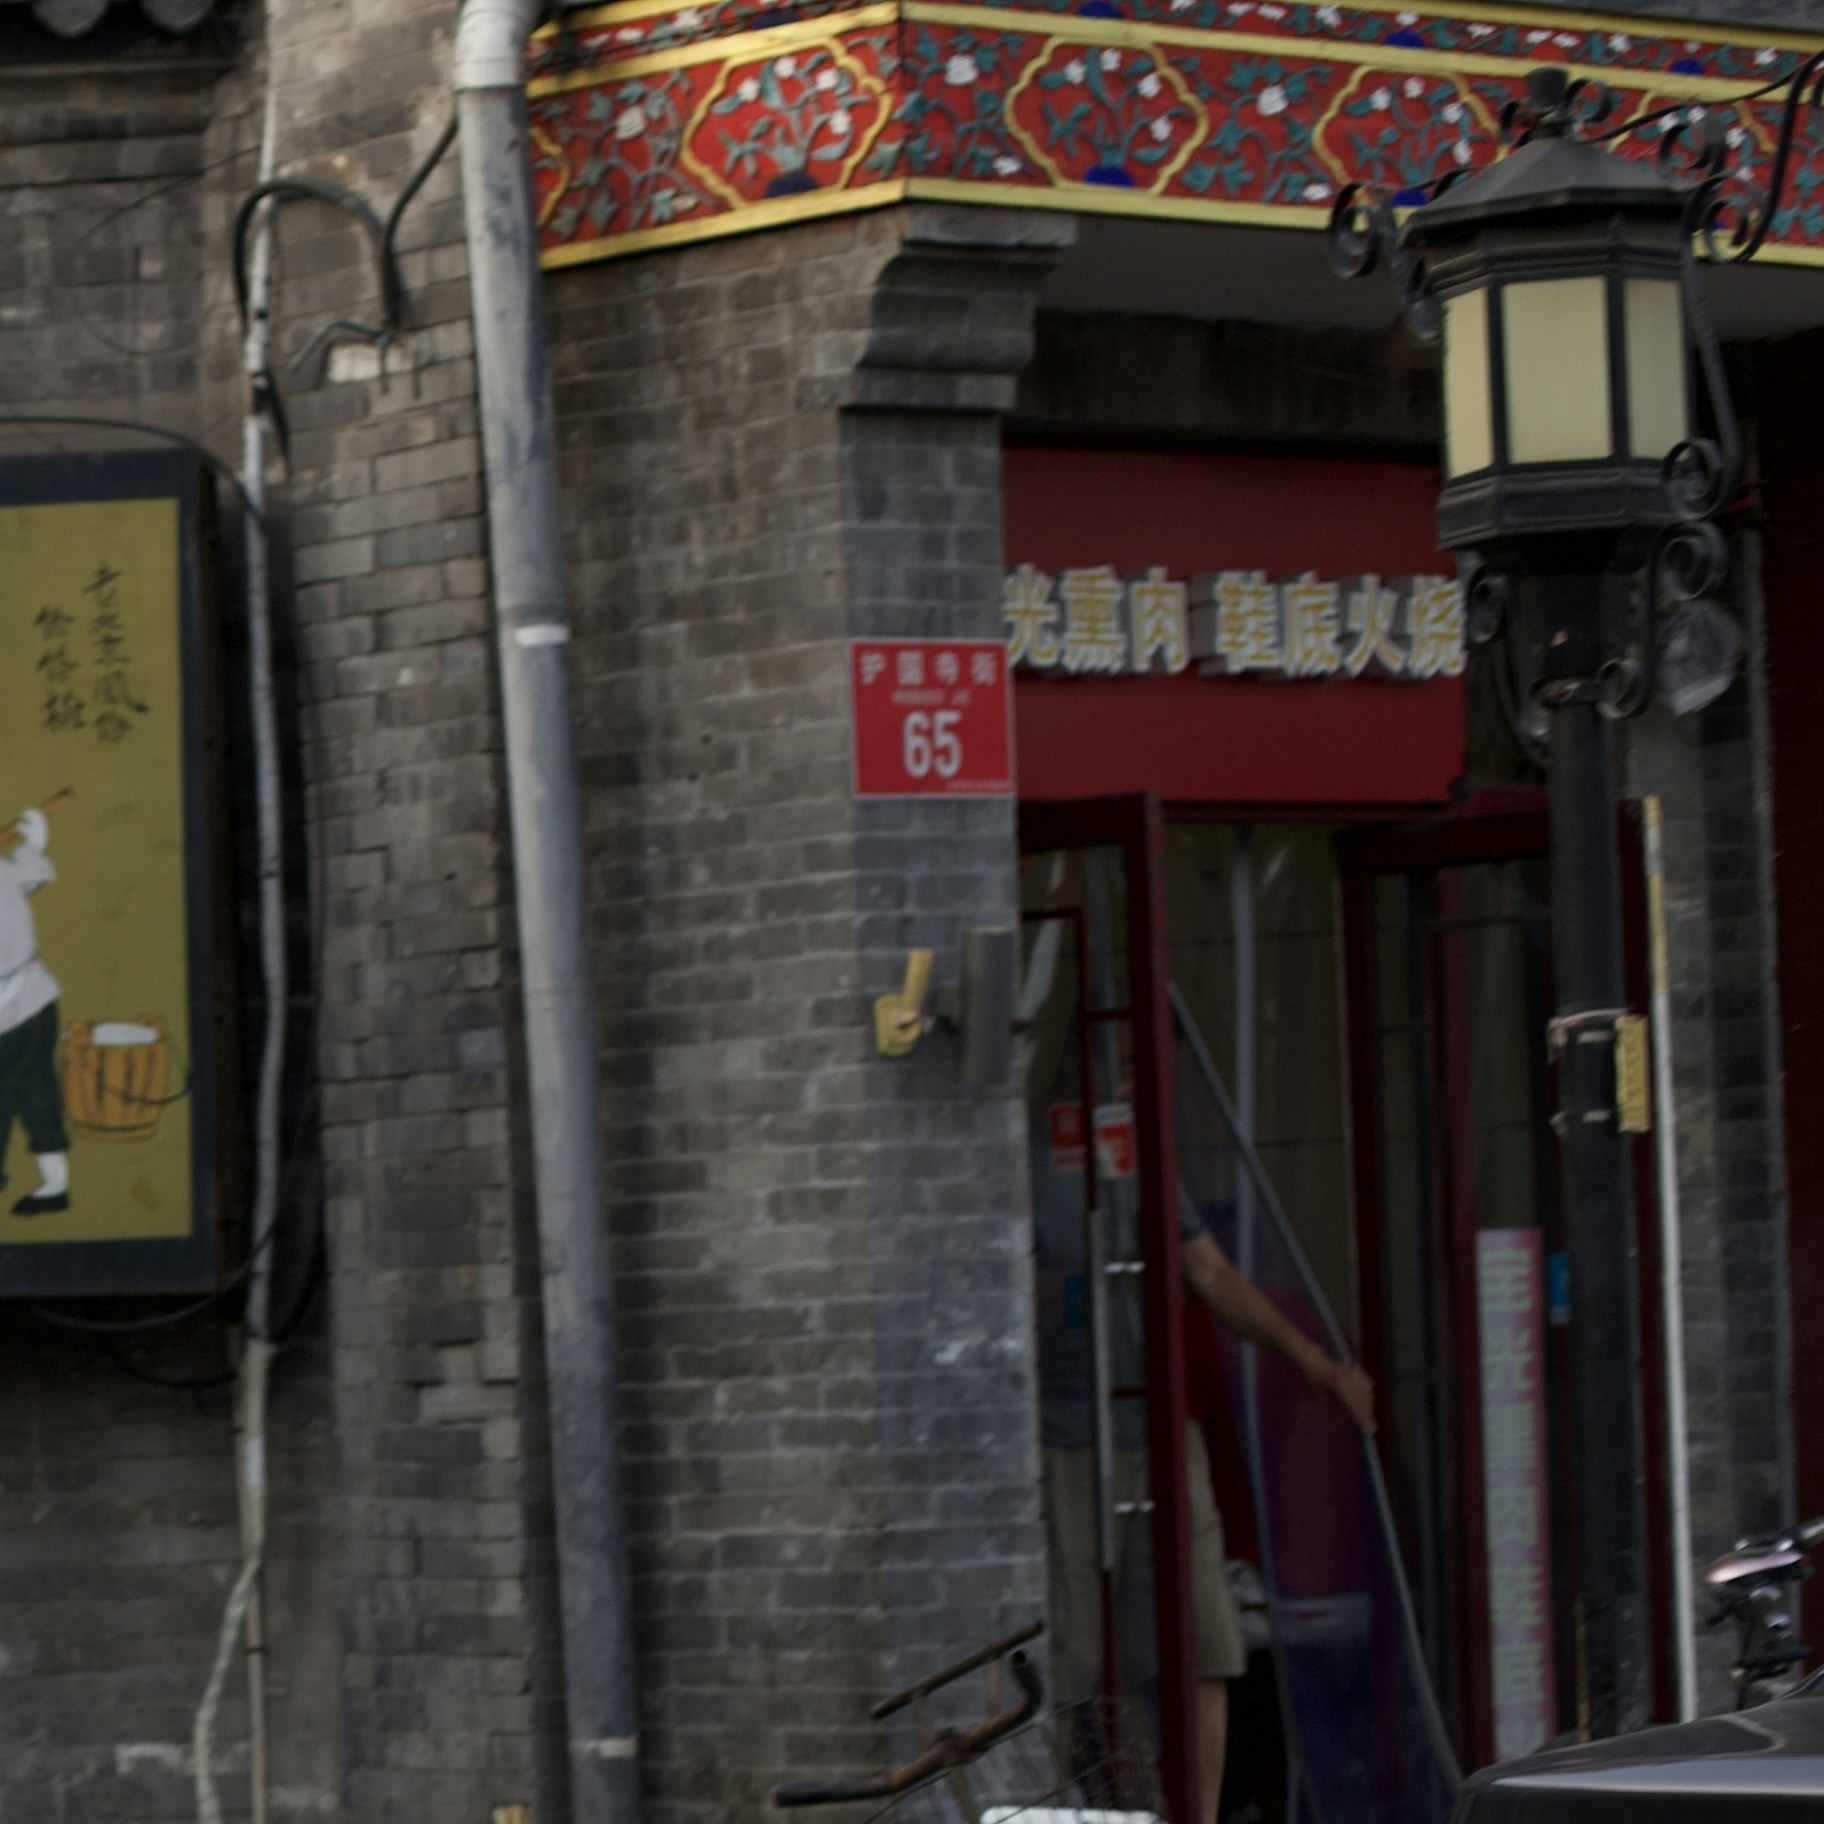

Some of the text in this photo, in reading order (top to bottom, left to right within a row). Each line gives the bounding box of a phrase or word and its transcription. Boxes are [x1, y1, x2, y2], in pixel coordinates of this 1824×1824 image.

[1003, 563, 1468, 681] 光熏肉 鞋底火烧
[904, 709, 963, 778] 65
